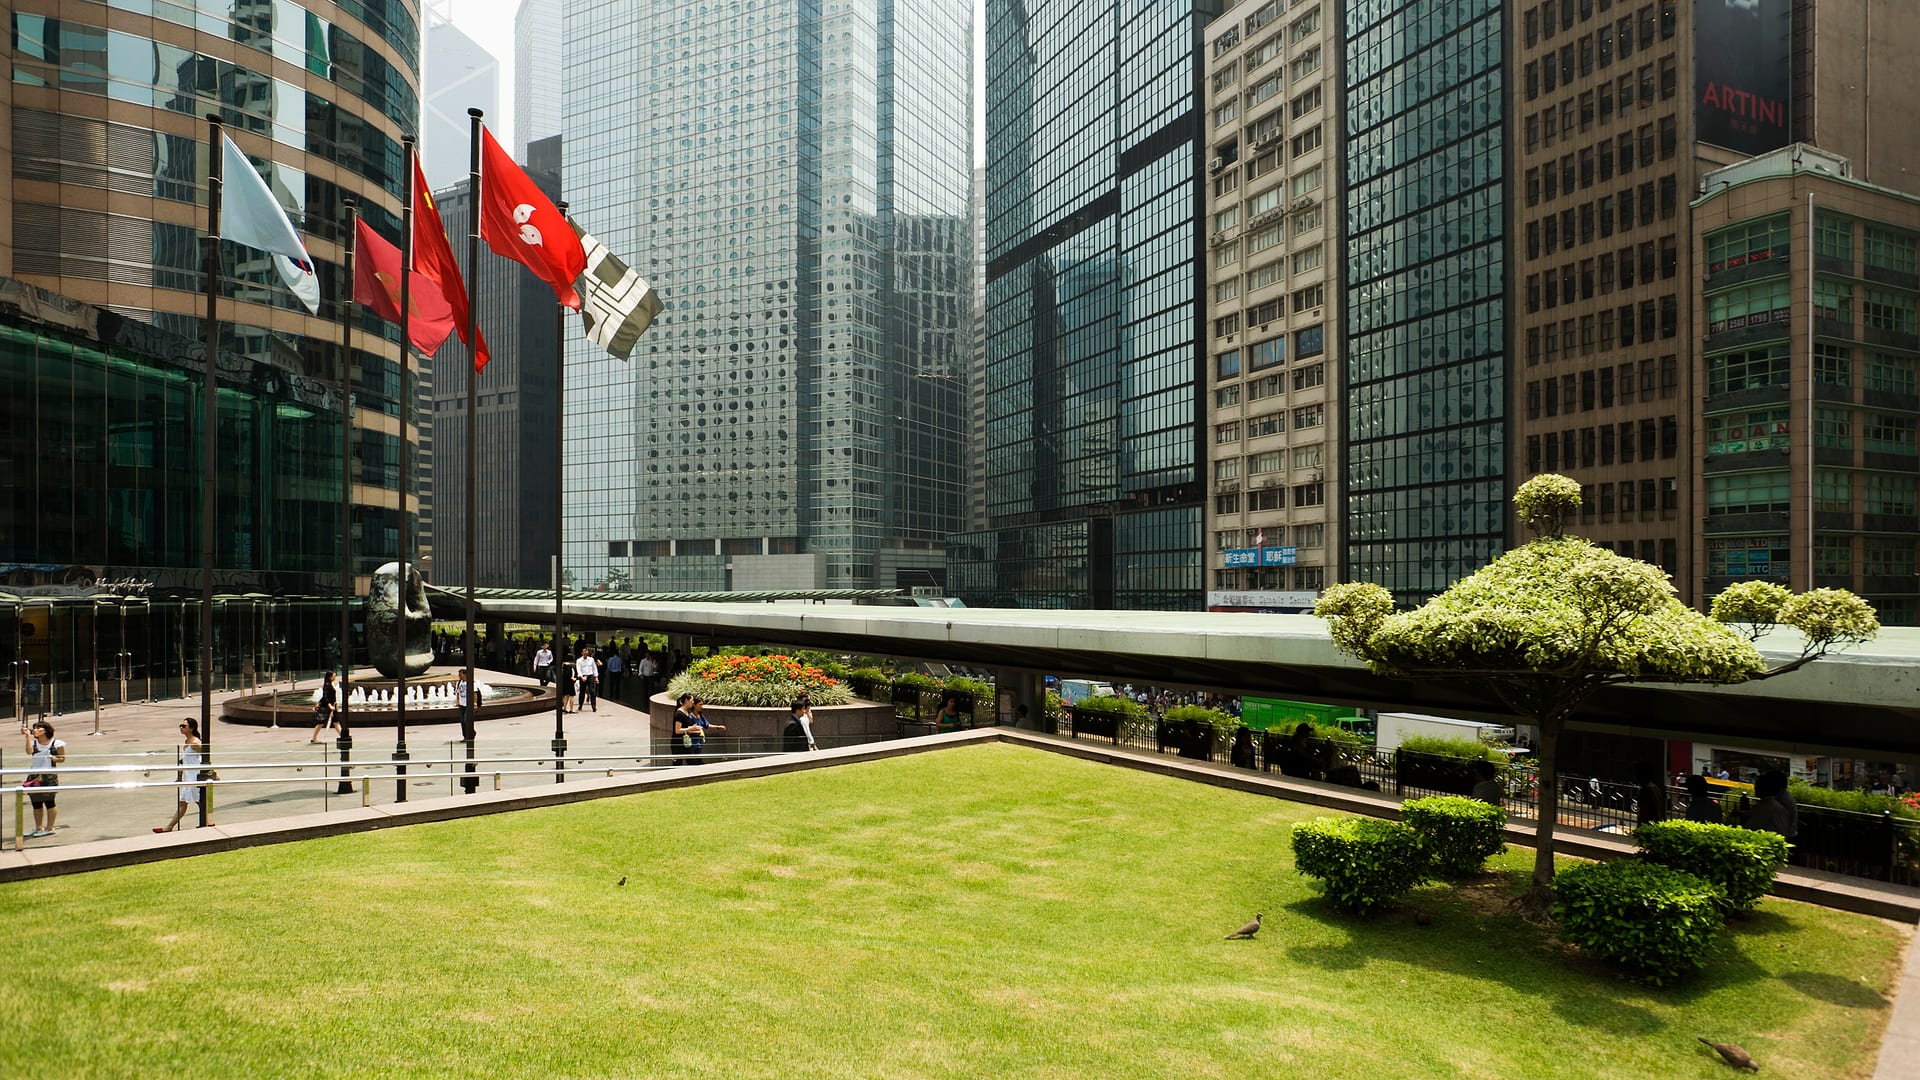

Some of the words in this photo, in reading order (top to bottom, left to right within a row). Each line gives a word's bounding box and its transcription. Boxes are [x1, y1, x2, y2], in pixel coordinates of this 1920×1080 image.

[1703, 80, 1783, 128] ARTINI
[1713, 422, 1790, 441] LOAN
[1748, 538, 1768, 547] LTD
[1749, 565, 1769, 574] RTC
